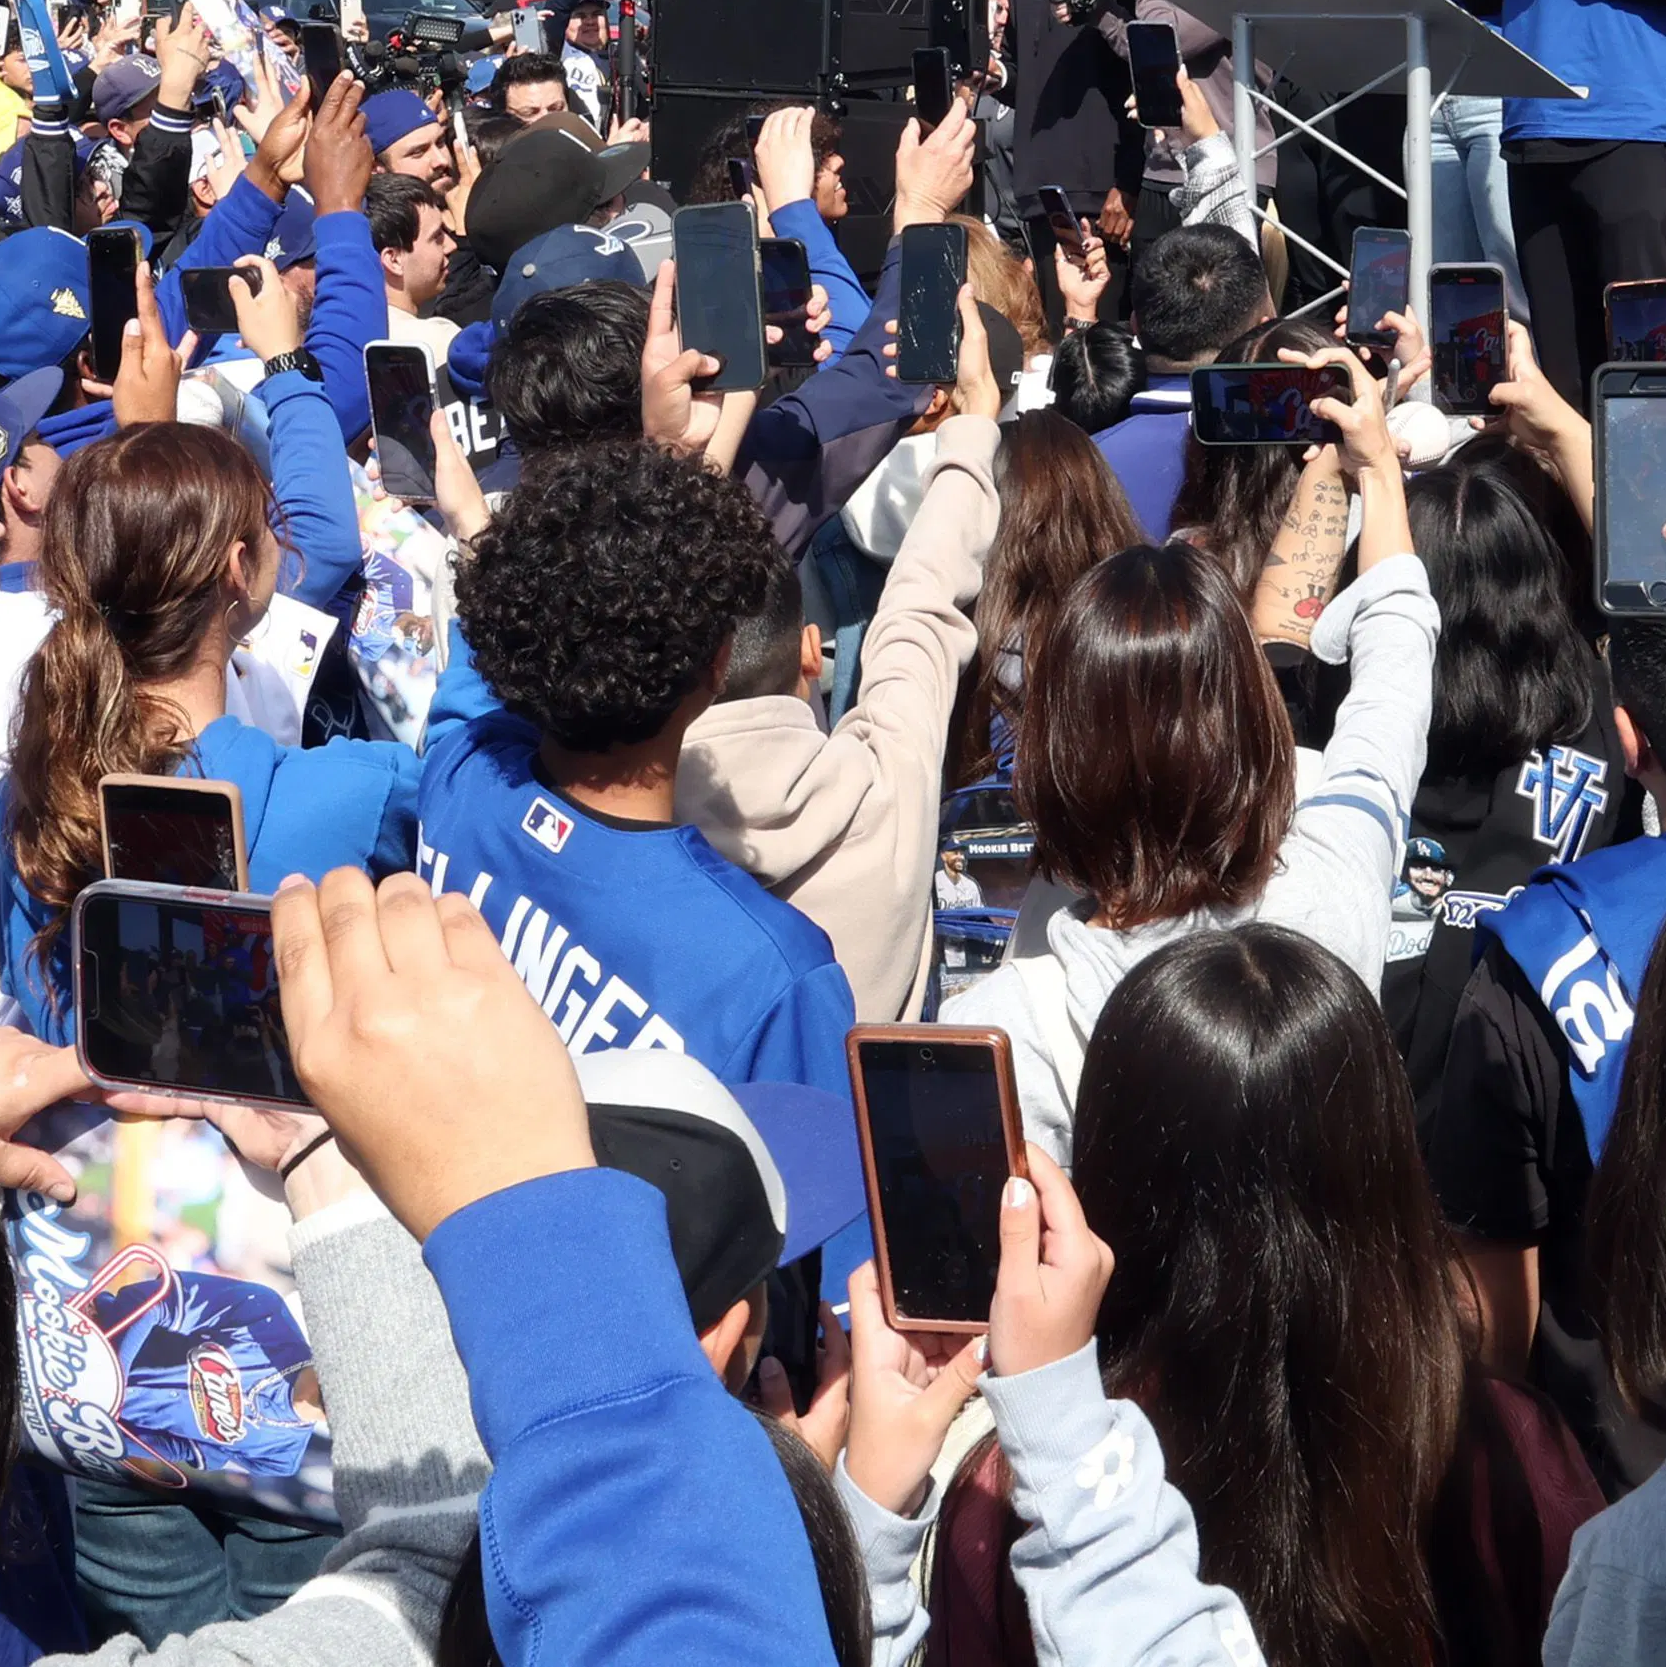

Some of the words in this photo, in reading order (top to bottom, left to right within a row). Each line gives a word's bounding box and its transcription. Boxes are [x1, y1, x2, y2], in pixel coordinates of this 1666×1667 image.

[444, 396, 507, 457] BE
[969, 844, 1008, 855] MOOKIE
[1010, 842, 1035, 854] BET
[1515, 744, 1610, 867] LA
[20, 1190, 91, 1388] Mookie
